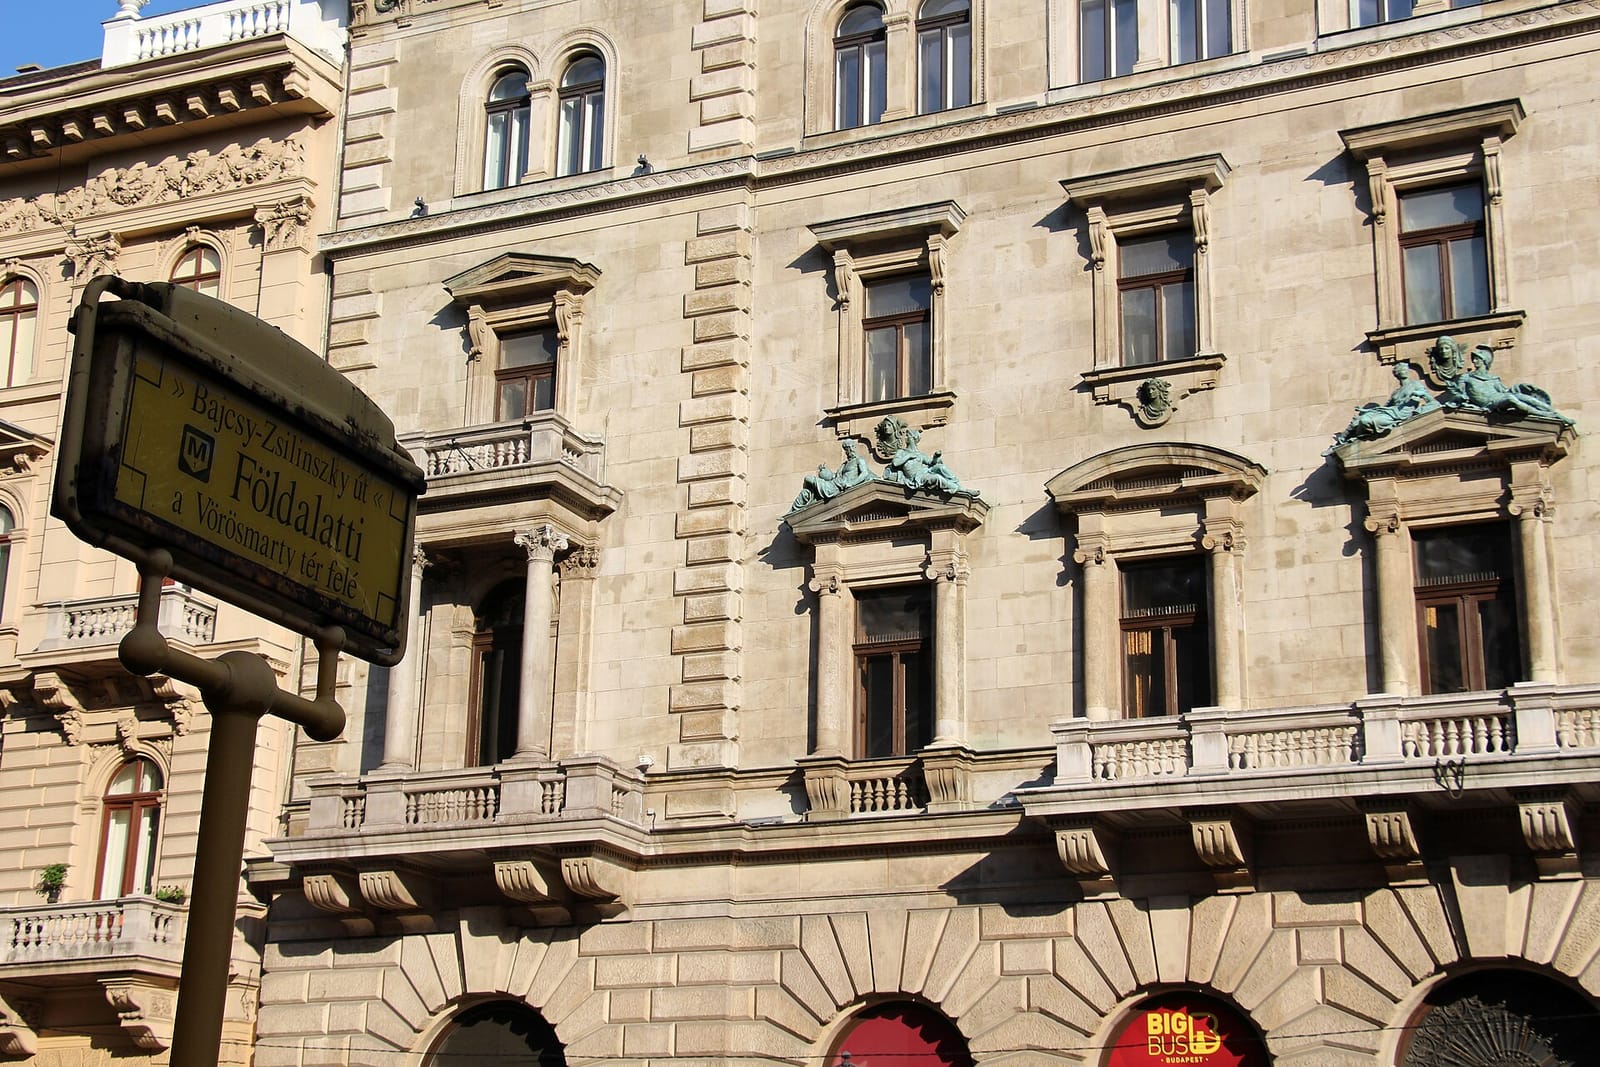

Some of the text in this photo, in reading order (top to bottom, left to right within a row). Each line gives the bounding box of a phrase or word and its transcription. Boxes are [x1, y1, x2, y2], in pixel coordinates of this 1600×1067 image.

[187, 435, 208, 463] M
[190, 381, 369, 504] Bajcsy-Zsilinszky út
[229, 450, 364, 563] Földalatti
[171, 490, 359, 600] a Vörösmarty tér felé
[1147, 1012, 1188, 1035] BIG
[1148, 1035, 1188, 1056] BUS
[1165, 1056, 1203, 1064] BUDAPEST
